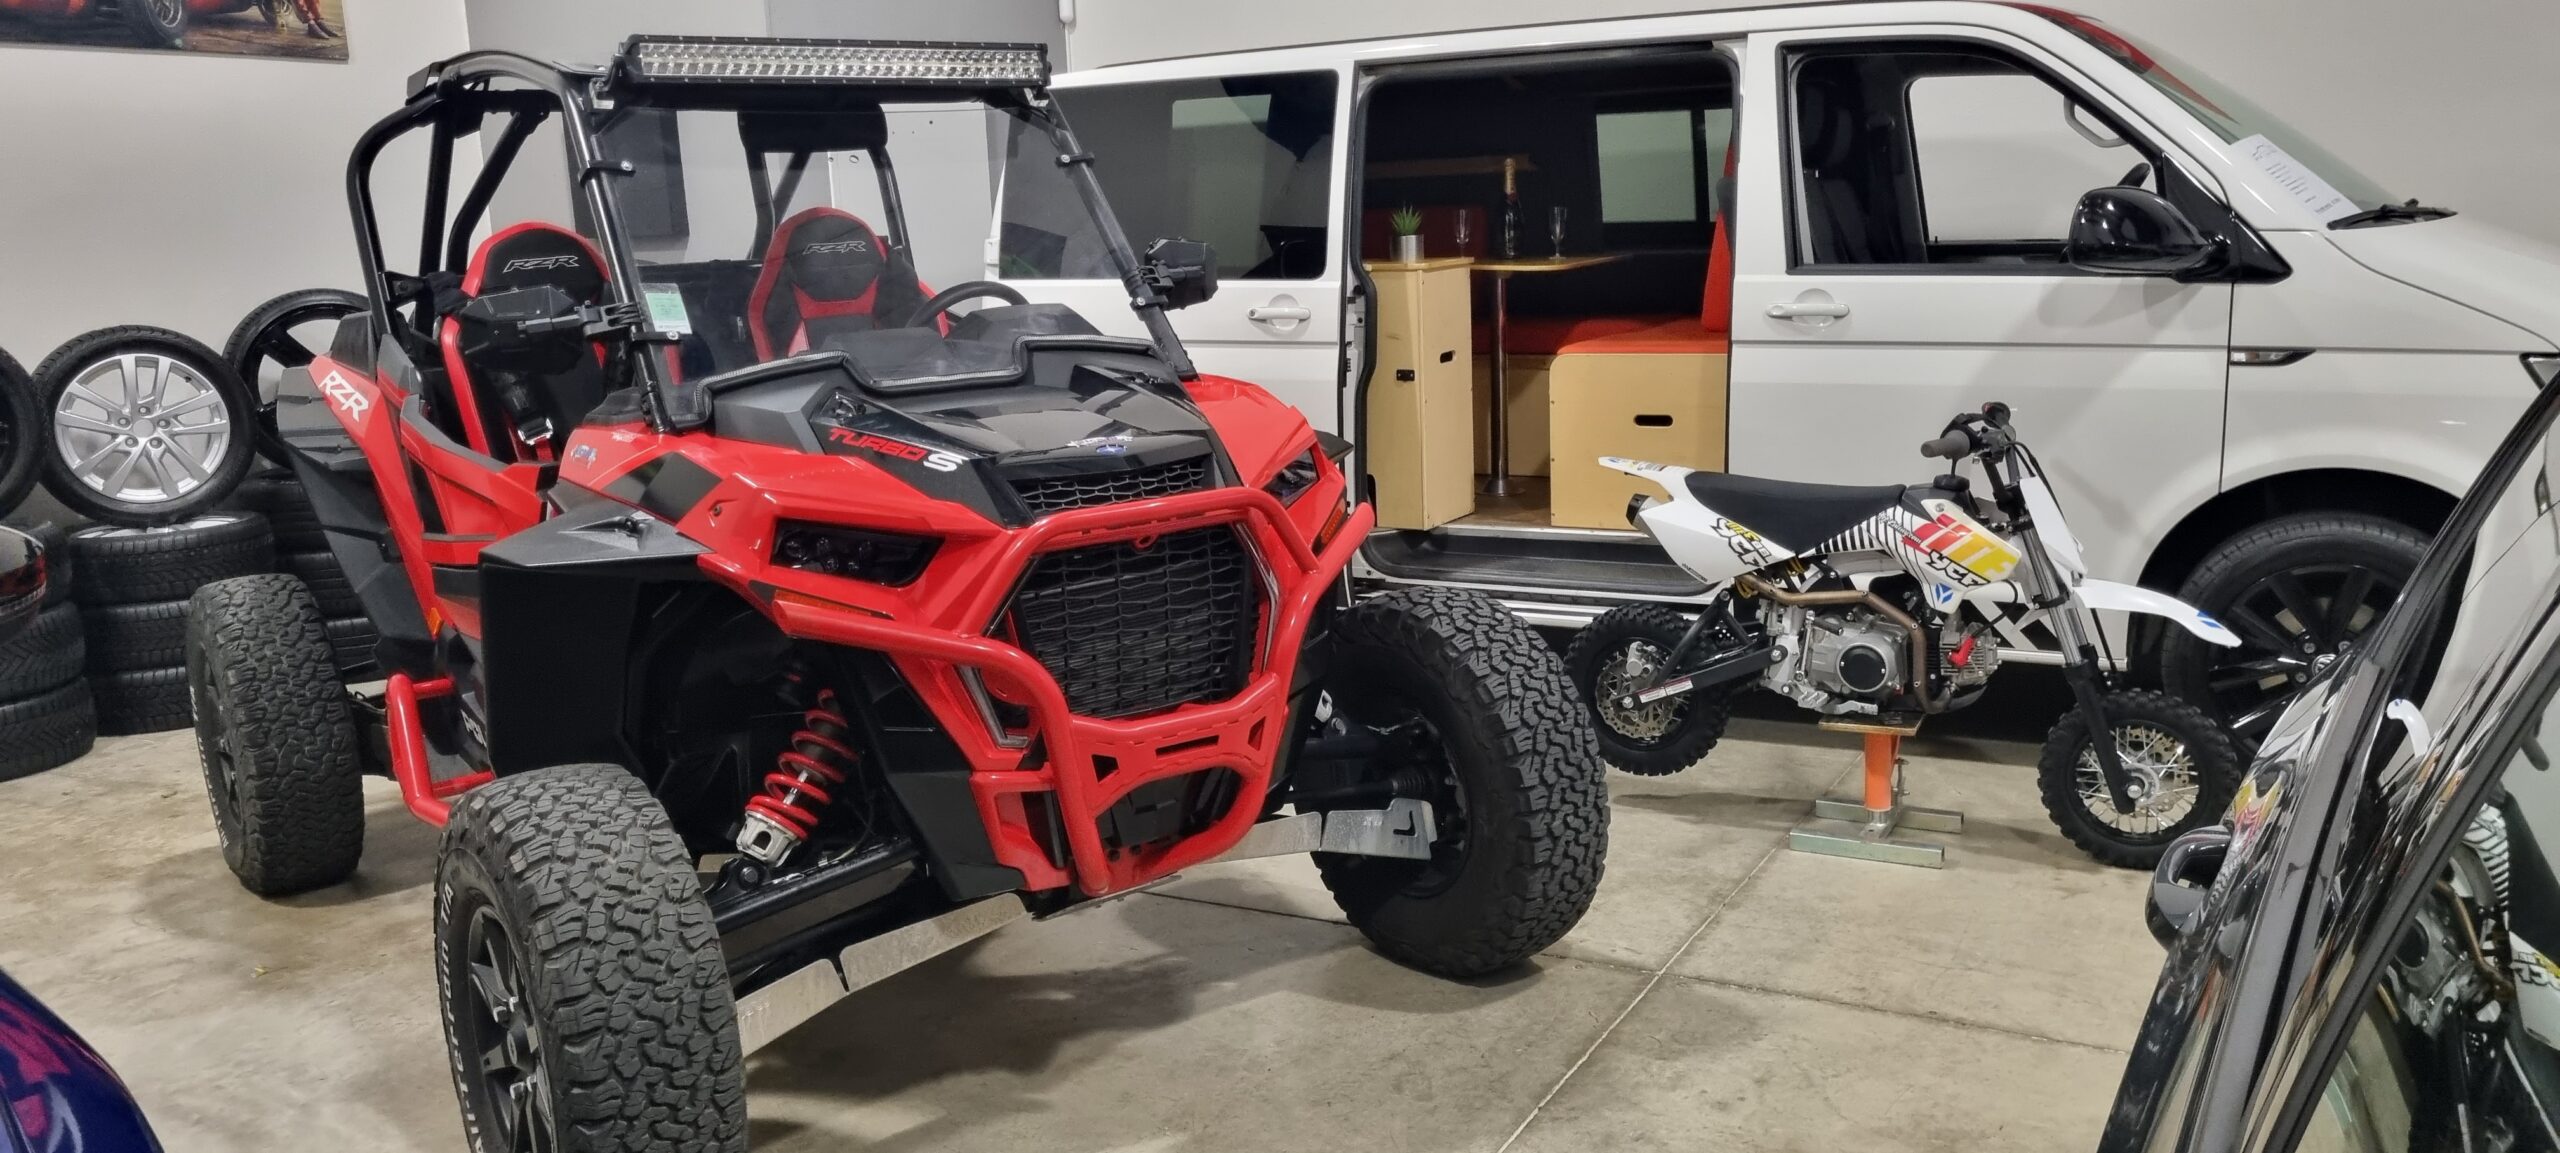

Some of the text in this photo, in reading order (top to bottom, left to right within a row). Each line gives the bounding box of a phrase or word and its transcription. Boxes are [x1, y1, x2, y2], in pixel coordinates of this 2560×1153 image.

[502, 255, 580, 273] RZR
[802, 240, 866, 255] RZR
[318, 370, 369, 422] RZR
[829, 427, 963, 472] TURBO S
[440, 882, 454, 925] T/A
